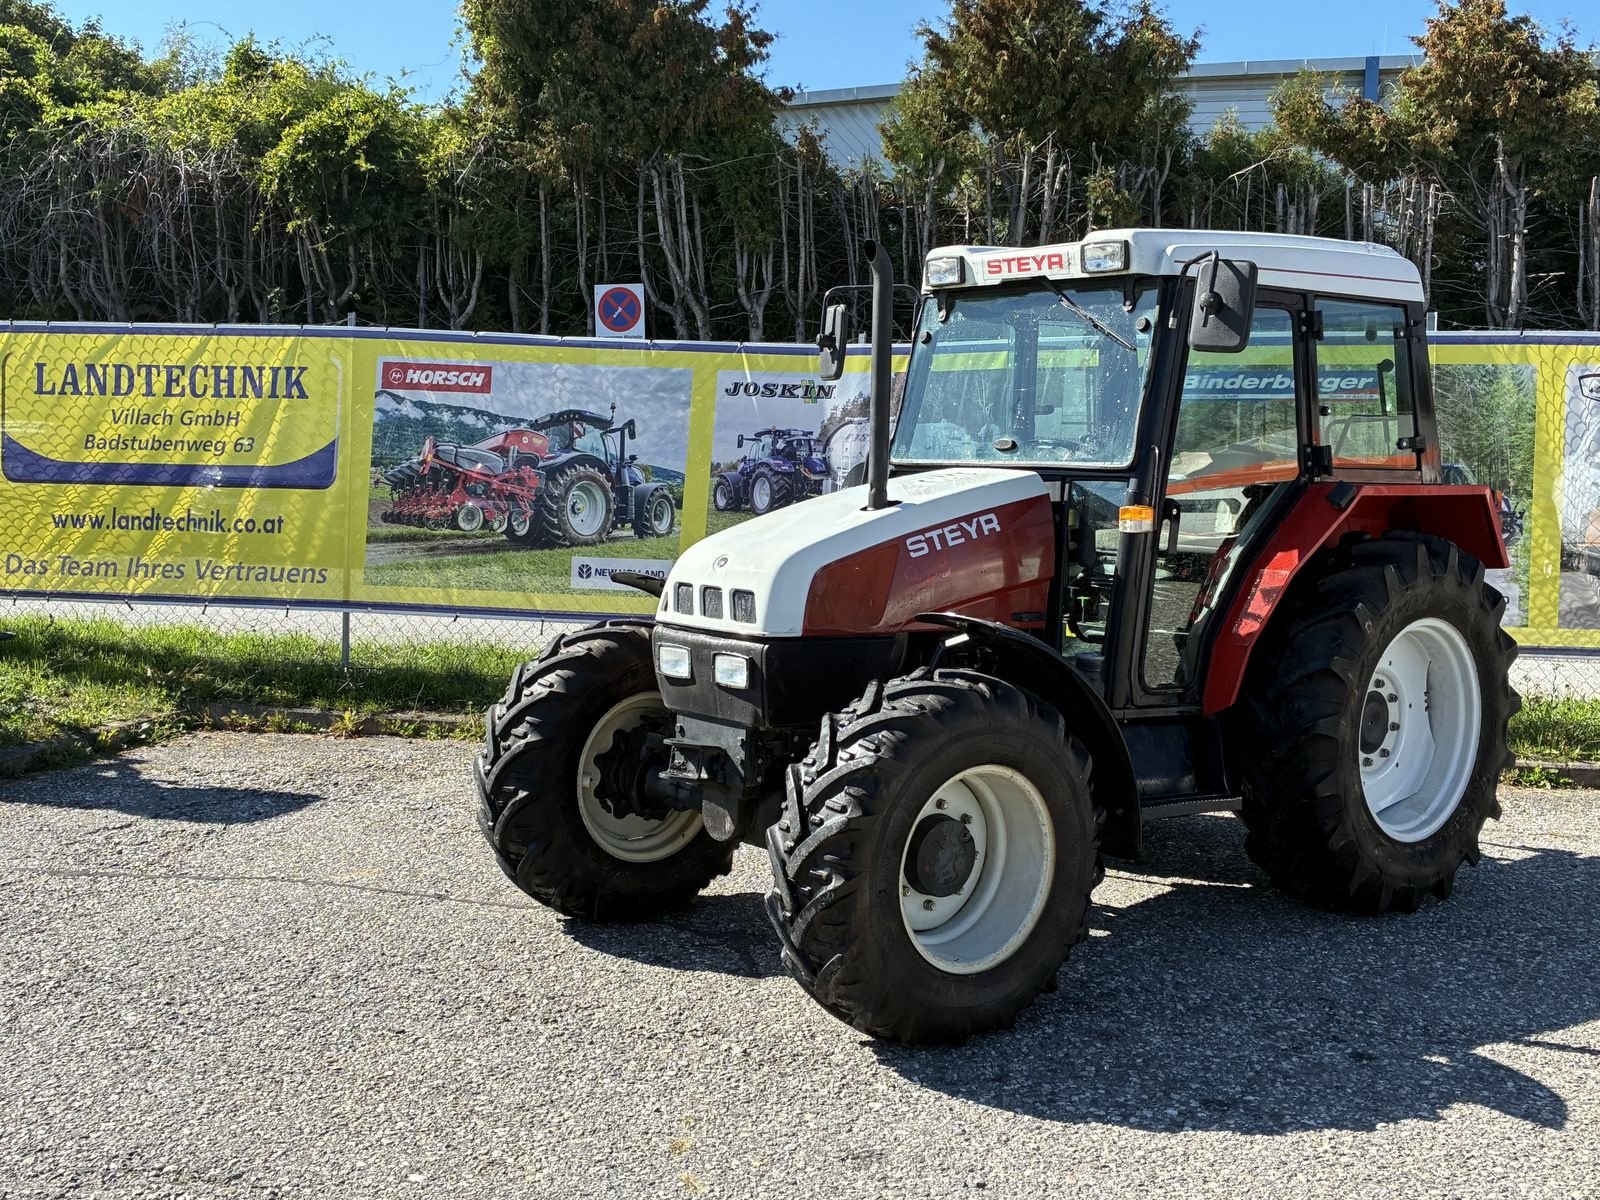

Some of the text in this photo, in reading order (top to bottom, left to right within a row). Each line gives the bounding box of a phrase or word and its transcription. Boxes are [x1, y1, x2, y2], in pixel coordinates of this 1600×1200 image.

[986, 253, 1064, 276] STEYR
[34, 362, 309, 400] LANDTECHNIK
[405, 369, 486, 387] HORSCH
[1183, 373, 1375, 392] Binderbger
[725, 382, 836, 399] JOSKIN
[111, 408, 241, 428] Villach GmbH
[84, 433, 255, 456] Badstubenweg 63
[51, 507, 285, 535] www.landtechnik.co.at
[906, 513, 1001, 558] STEYR
[5, 554, 328, 585] Das Team Ihres Vertrauens
